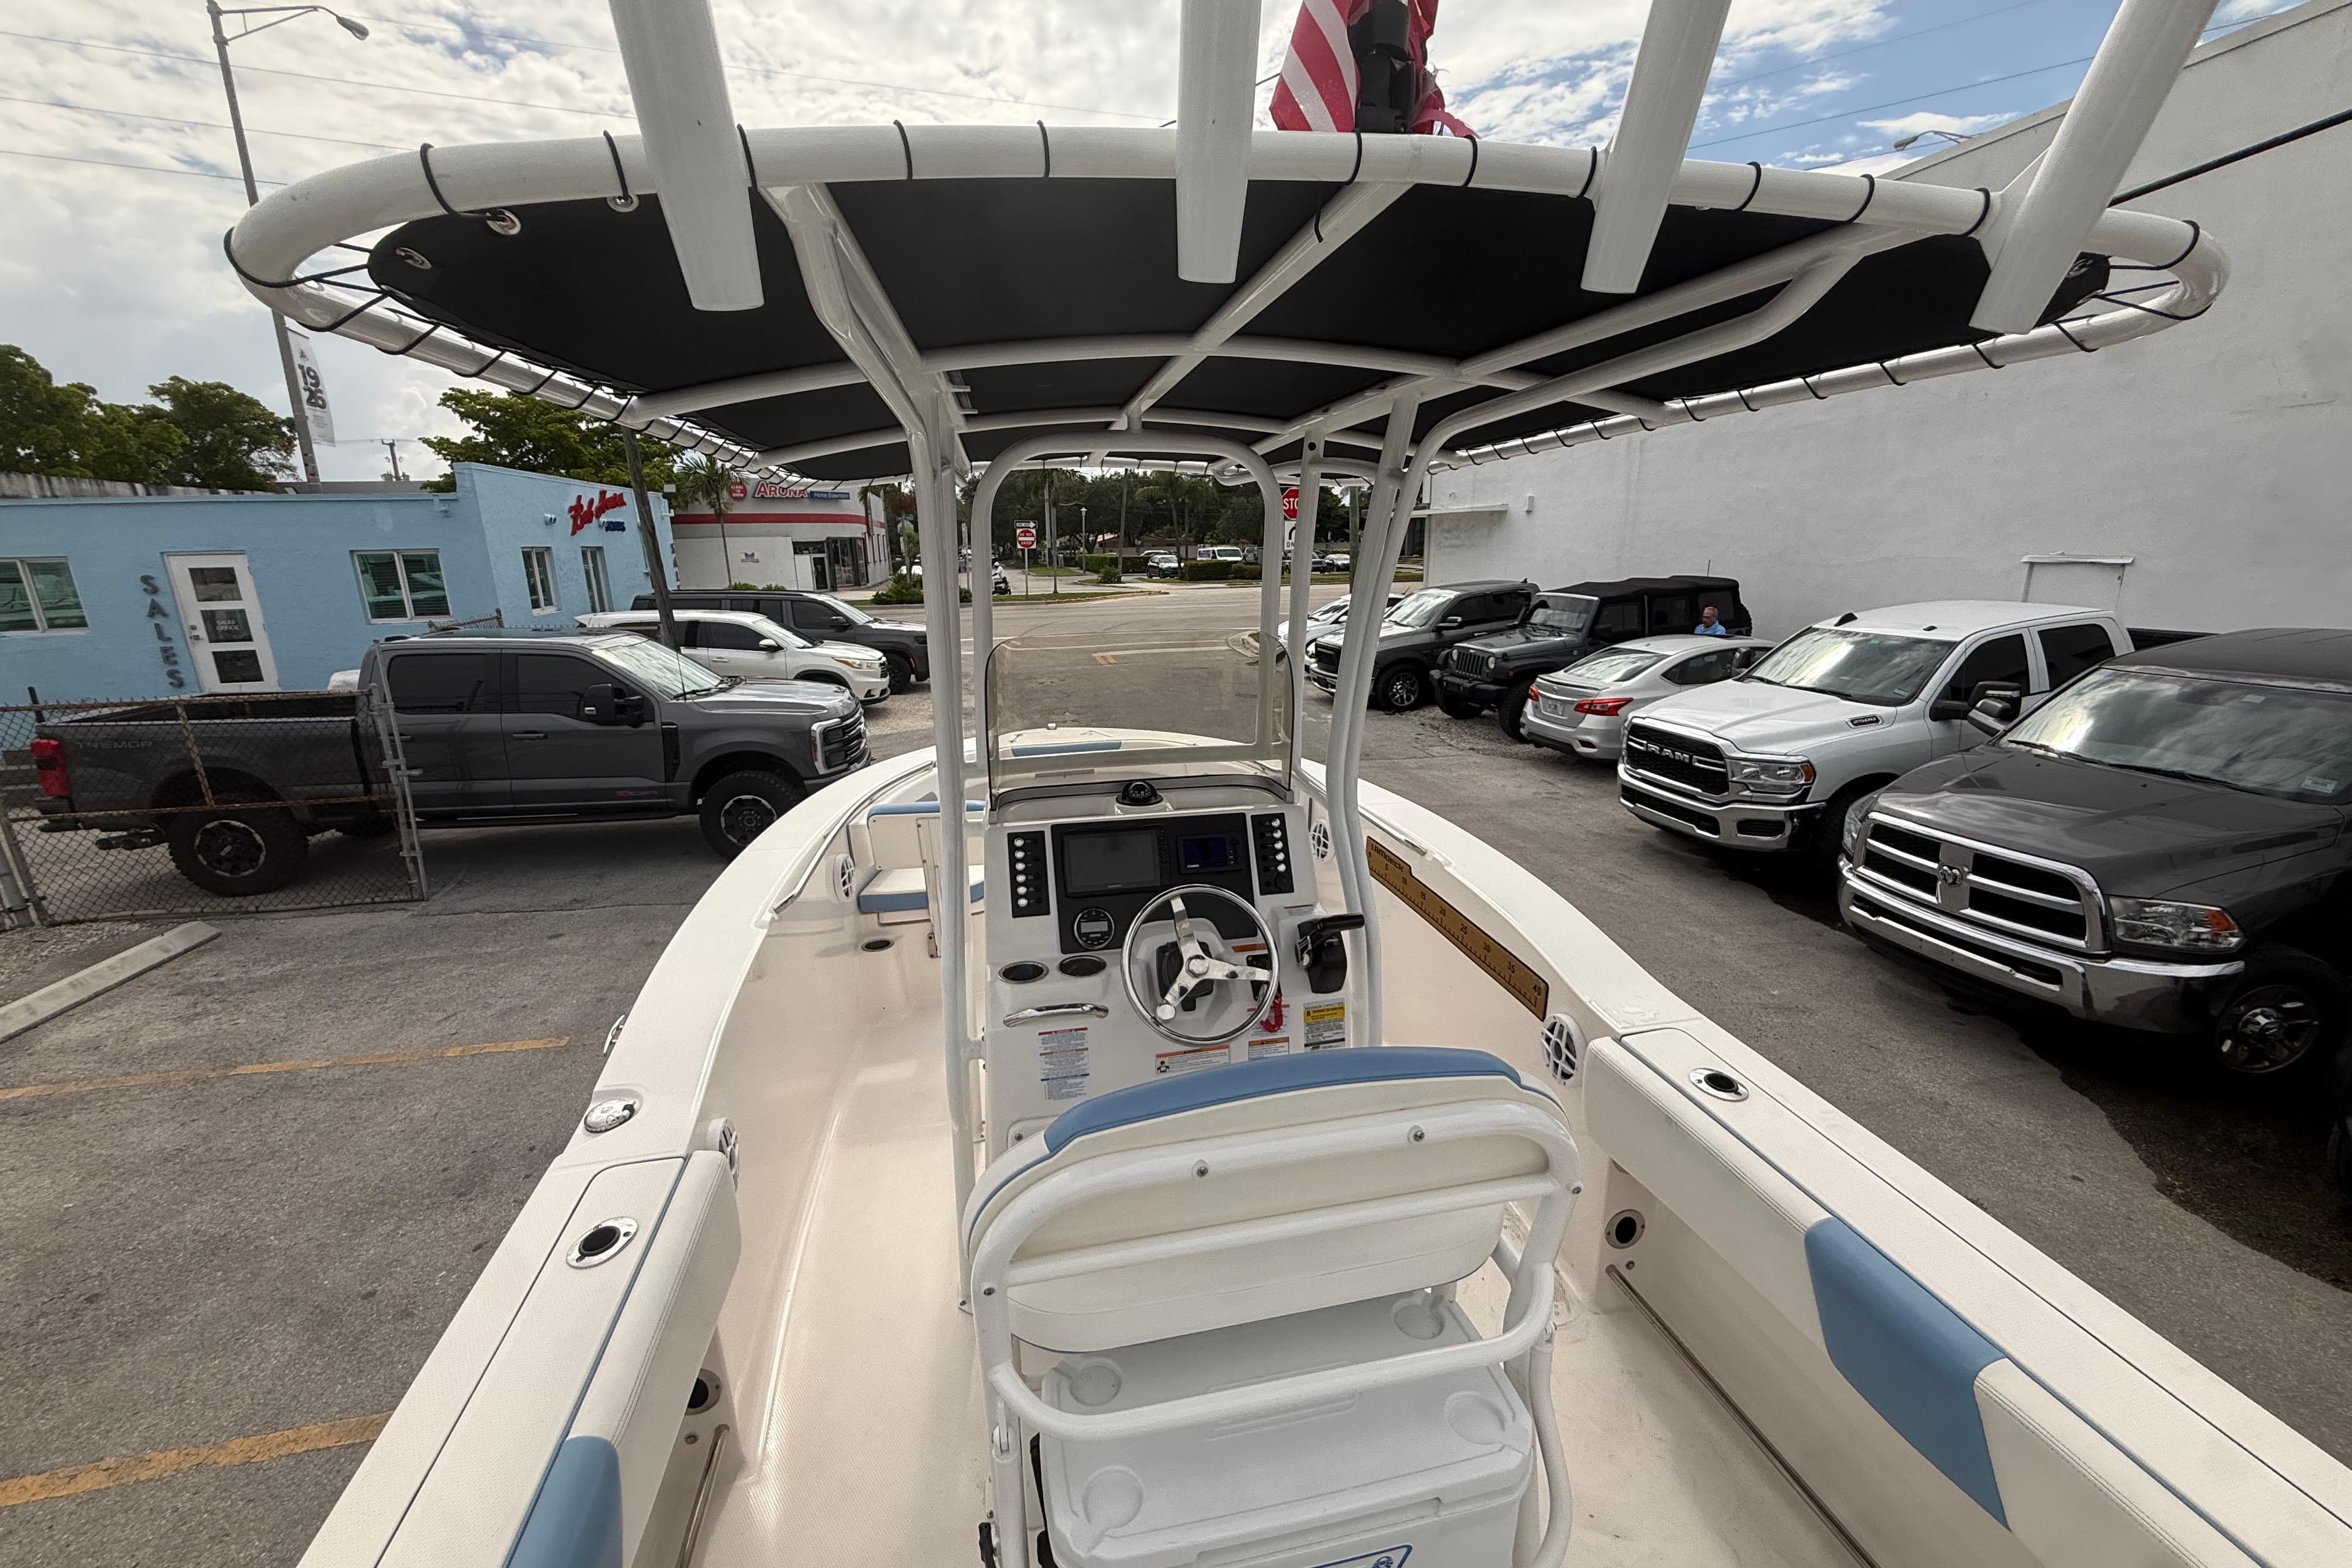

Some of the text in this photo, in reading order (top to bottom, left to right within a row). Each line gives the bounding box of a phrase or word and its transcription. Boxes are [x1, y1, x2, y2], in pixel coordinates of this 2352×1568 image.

[298, 363, 320, 388] 19
[755, 481, 809, 497] ARONA
[1283, 498, 1299, 510] STO
[140, 575, 184, 688] SALES
[1647, 743, 1689, 763] RAM
[1420, 891, 1427, 901] 15
[1439, 906, 1446, 916] 20
[1460, 923, 1468, 935] 25
[1482, 941, 1491, 953] 30
[1507, 961, 1516, 974] 35
[1532, 984, 1542, 996] 40
